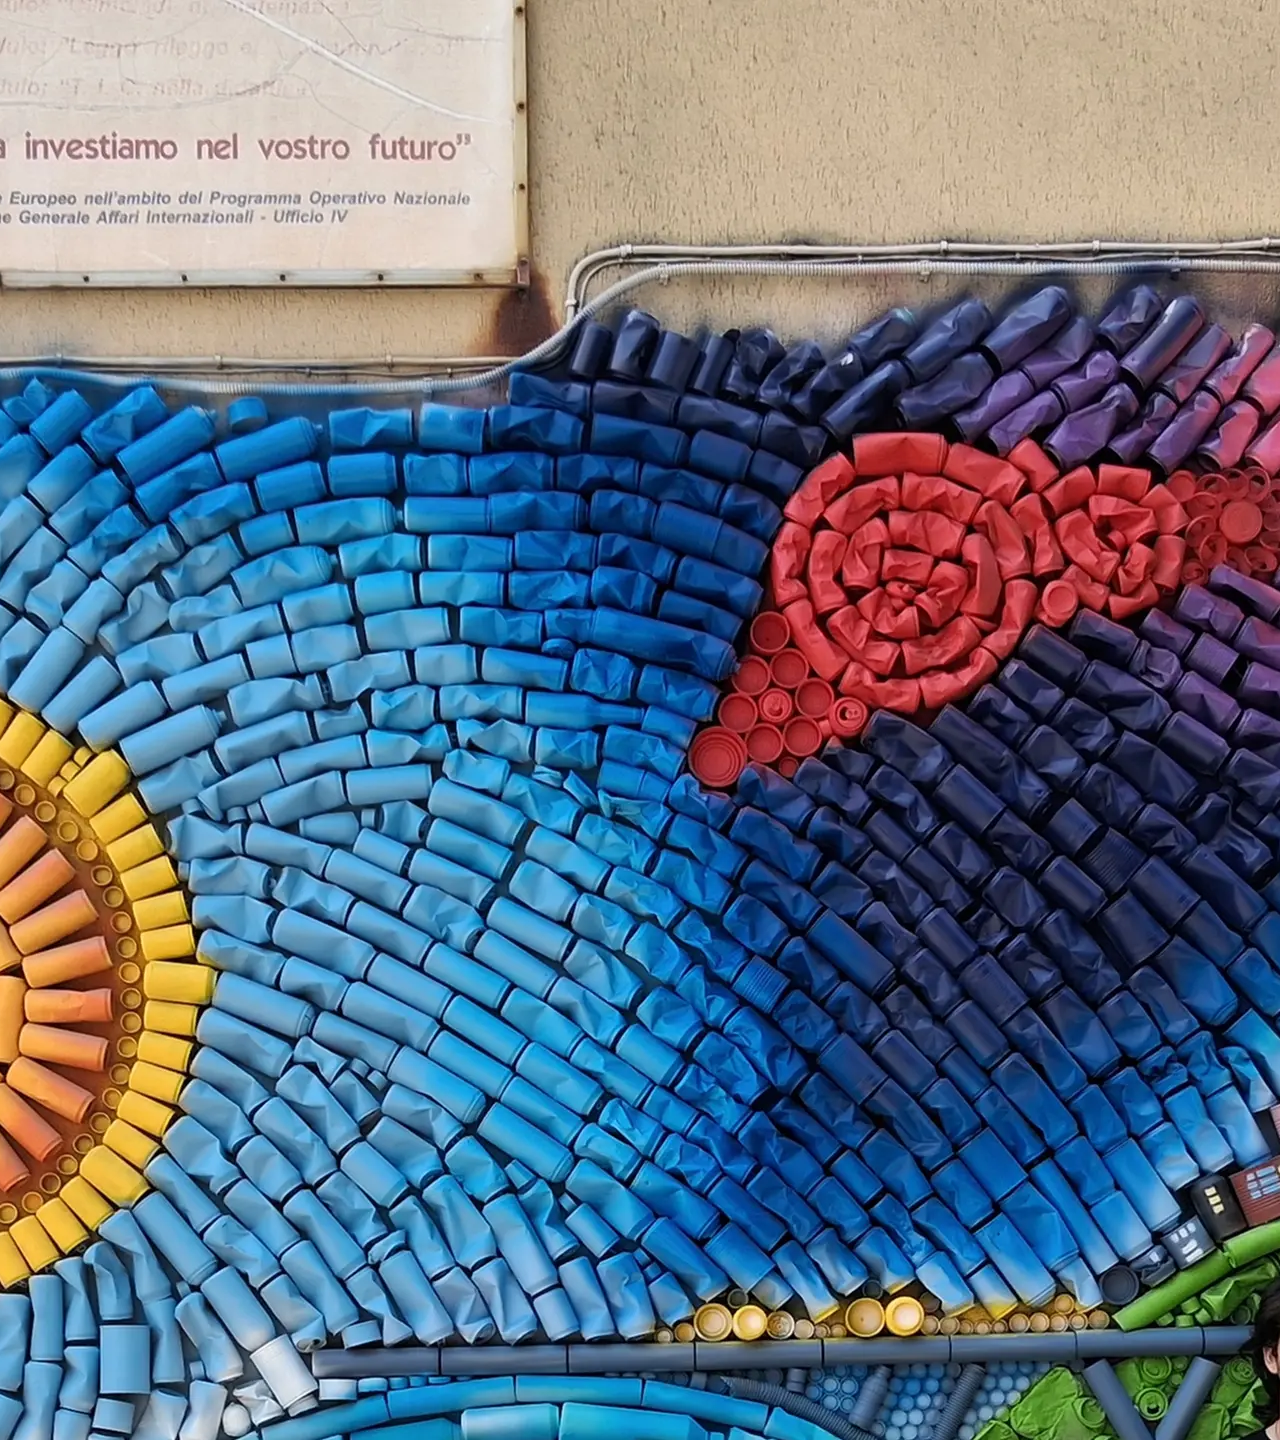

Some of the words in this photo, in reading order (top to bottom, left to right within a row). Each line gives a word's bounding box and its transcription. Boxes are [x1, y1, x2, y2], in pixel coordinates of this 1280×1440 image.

[24, 130, 179, 161] investiamo
[196, 131, 239, 161] nel
[257, 134, 351, 161] vostro
[368, 132, 472, 162] futuro”
[9, 190, 78, 208] Europeo
[83, 190, 172, 206] nell'ambito
[177, 190, 204, 205] del
[209, 190, 302, 208] Programma
[308, 190, 387, 208] Operativo
[393, 190, 471, 206] Nazionale
[18, 209, 91, 225] Generale
[95, 209, 140, 225] Affari
[145, 208, 255, 225] Internazionali
[273, 208, 325, 224] Ufficio
[330, 208, 349, 224] IV
